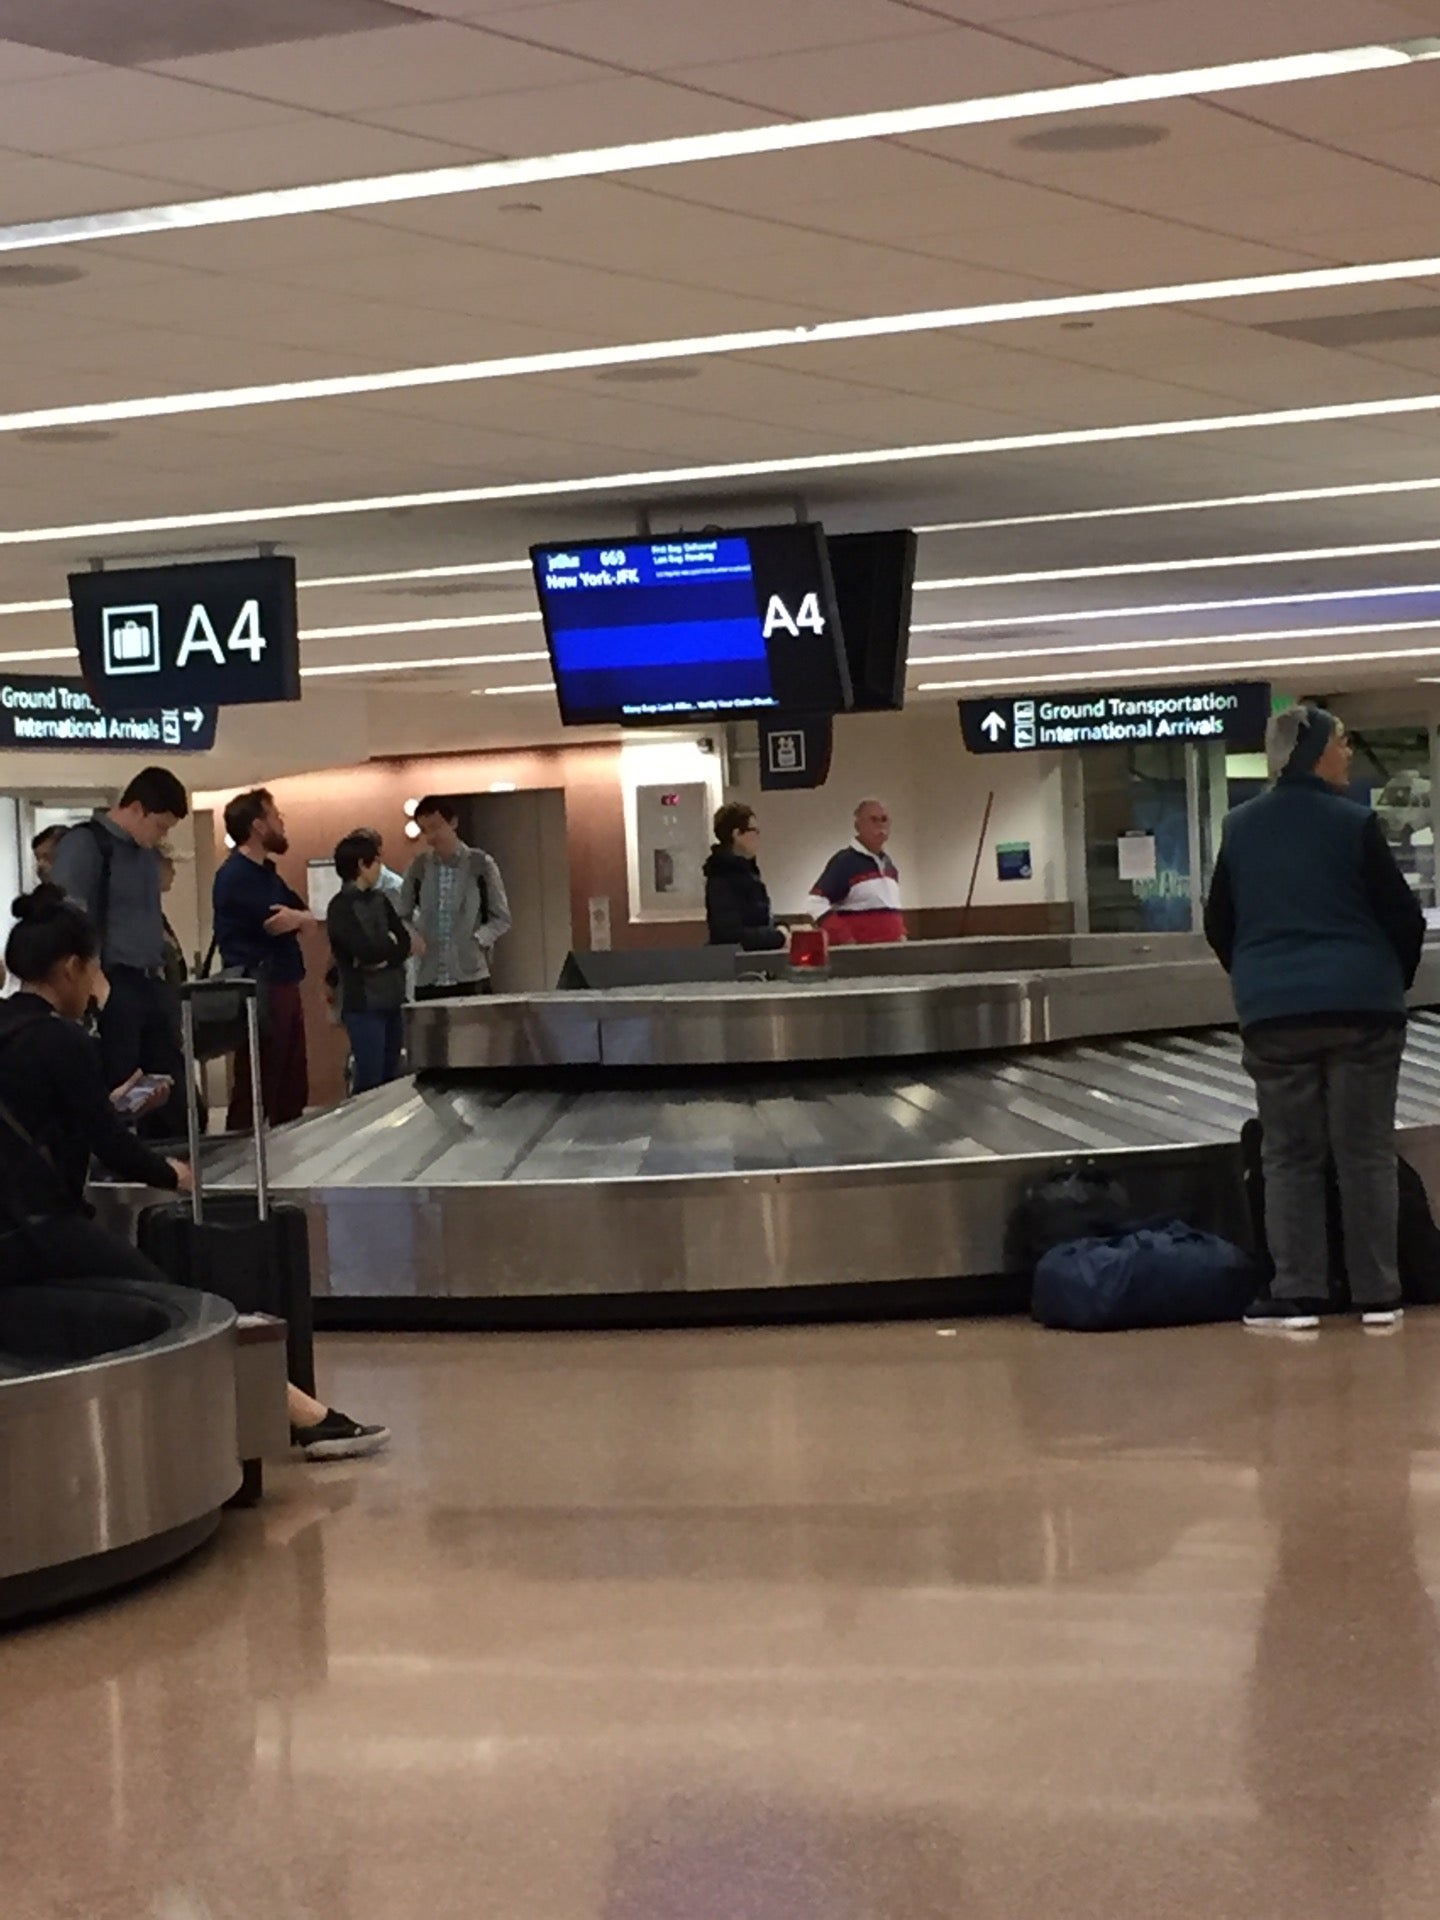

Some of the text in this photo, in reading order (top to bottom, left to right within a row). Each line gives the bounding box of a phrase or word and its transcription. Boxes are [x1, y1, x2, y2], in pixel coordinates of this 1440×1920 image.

[600, 550, 626, 566] 669
[546, 574, 577, 589] New
[580, 568, 640, 588] York-JFK
[762, 592, 825, 639] A4
[176, 599, 267, 668] A4
[1, 686, 56, 709] Ground
[1039, 693, 1238, 720] Ground Transportation
[14, 716, 160, 740] International Arrivals
[1040, 716, 1224, 743] International Arrivals
